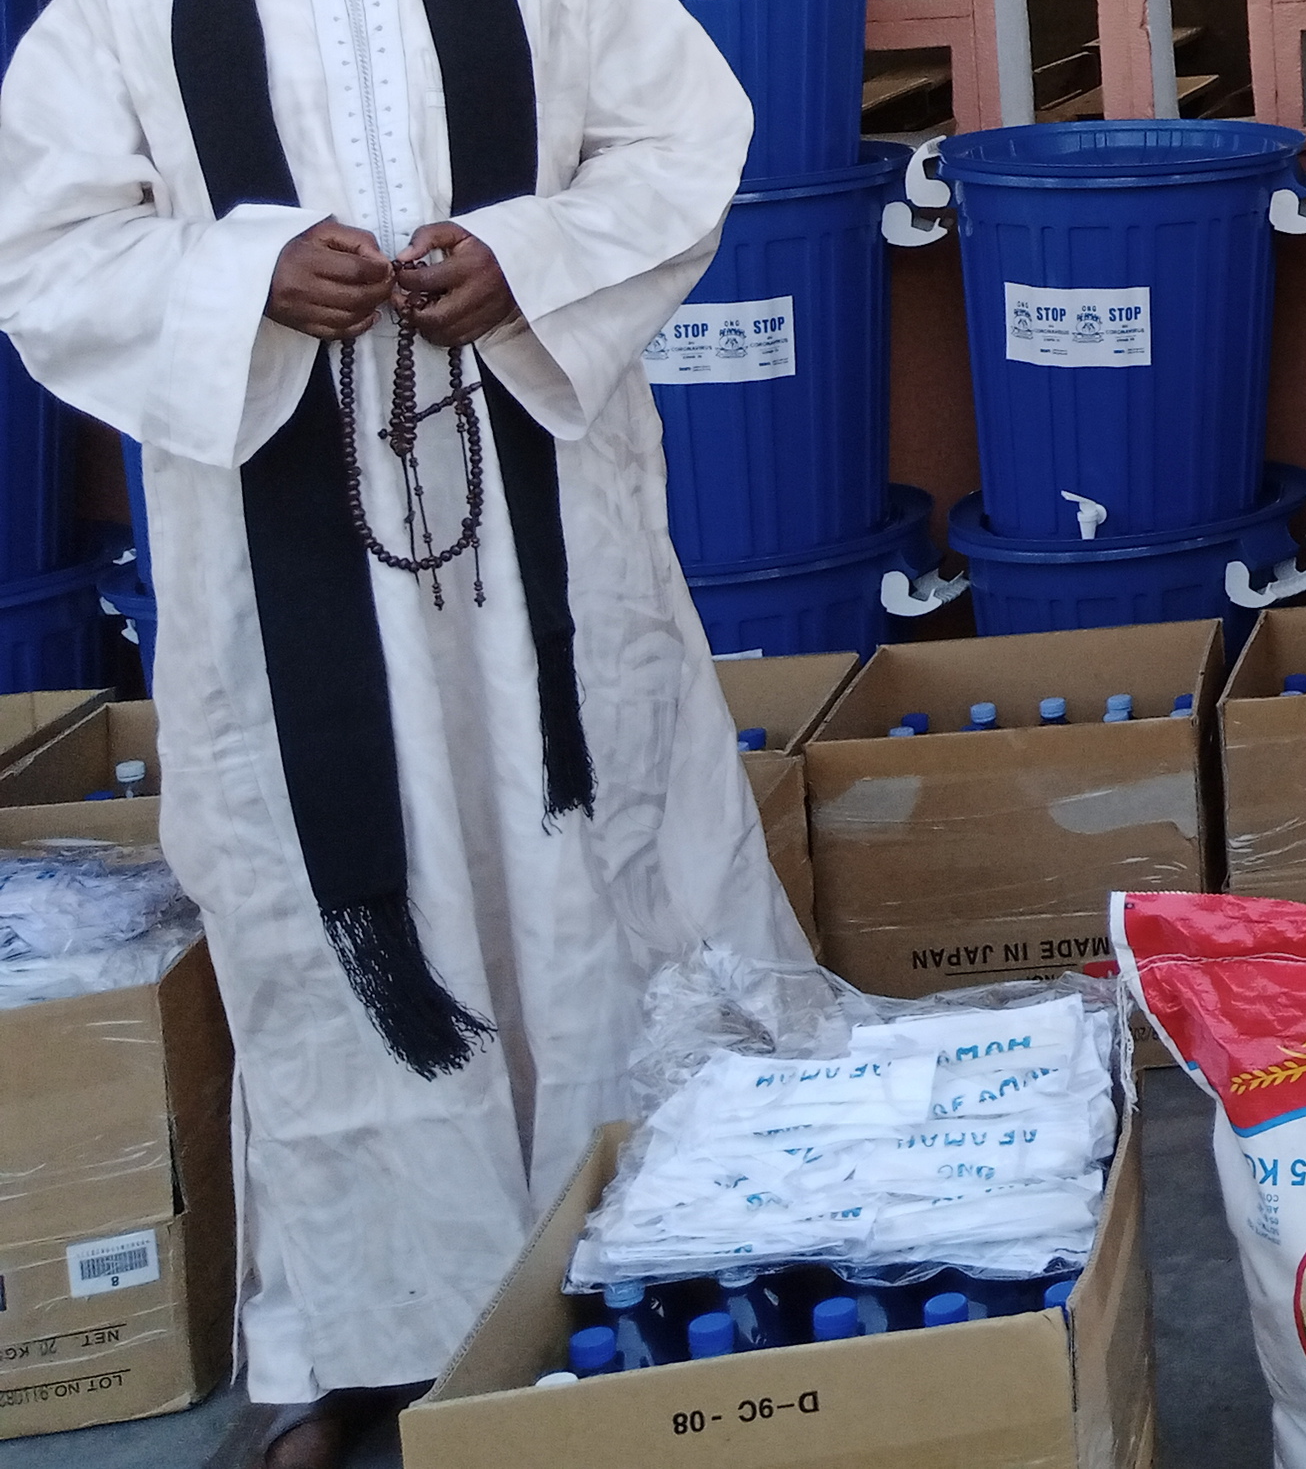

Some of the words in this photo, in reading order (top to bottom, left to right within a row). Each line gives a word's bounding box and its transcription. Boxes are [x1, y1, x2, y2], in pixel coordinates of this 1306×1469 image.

[1036, 306, 1067, 322] STOP
[1108, 306, 1142, 322] STOP
[674, 323, 709, 339] STOP
[753, 316, 785, 335] STOP
[911, 945, 994, 970] JAPAN
[1004, 942, 1028, 964] IN
[1040, 936, 1109, 961] MADE
[111, 1276, 120, 1287] 8
[81, 1329, 120, 1347] NET
[87, 1374, 123, 1392] LOT
